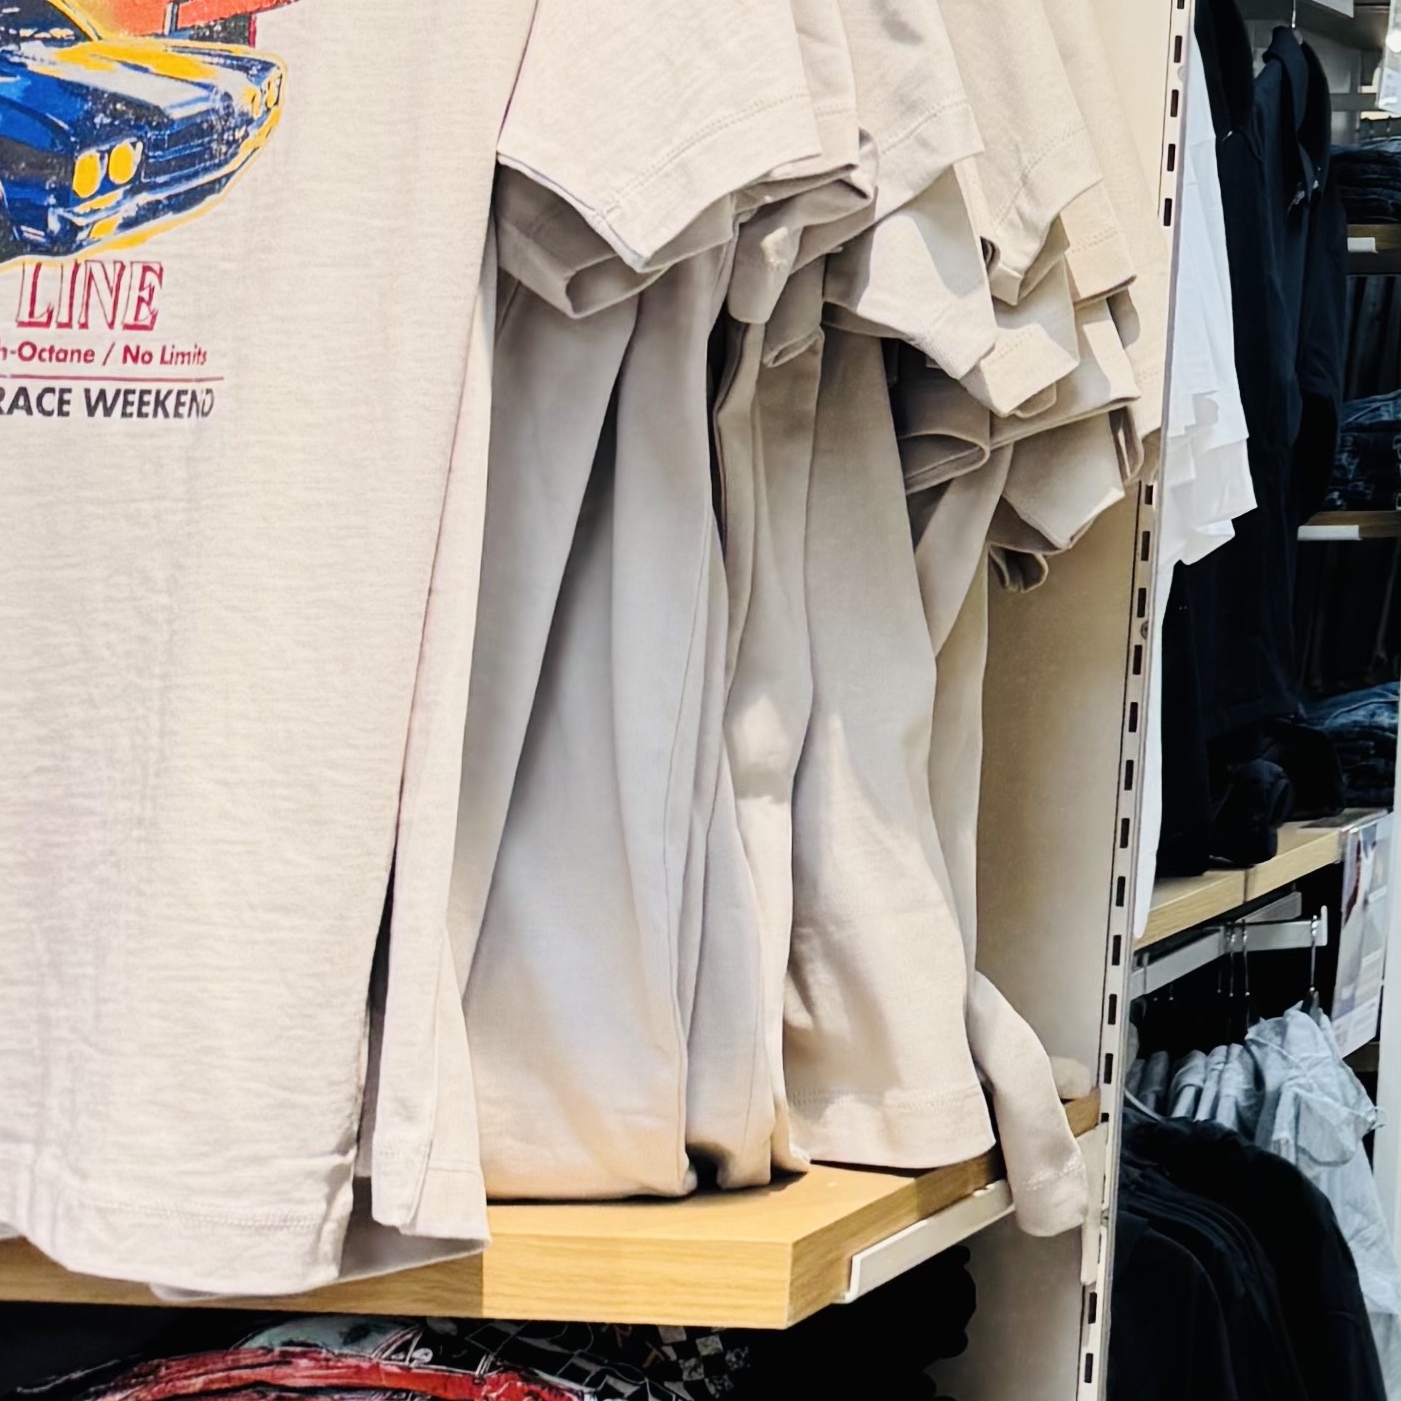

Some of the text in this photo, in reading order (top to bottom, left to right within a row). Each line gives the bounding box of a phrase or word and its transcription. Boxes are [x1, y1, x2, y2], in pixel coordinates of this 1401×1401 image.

[15, 259, 164, 332] LINE
[122, 344, 153, 366] No
[160, 343, 207, 367] Limits
[83, 387, 215, 420] WEEKEND
